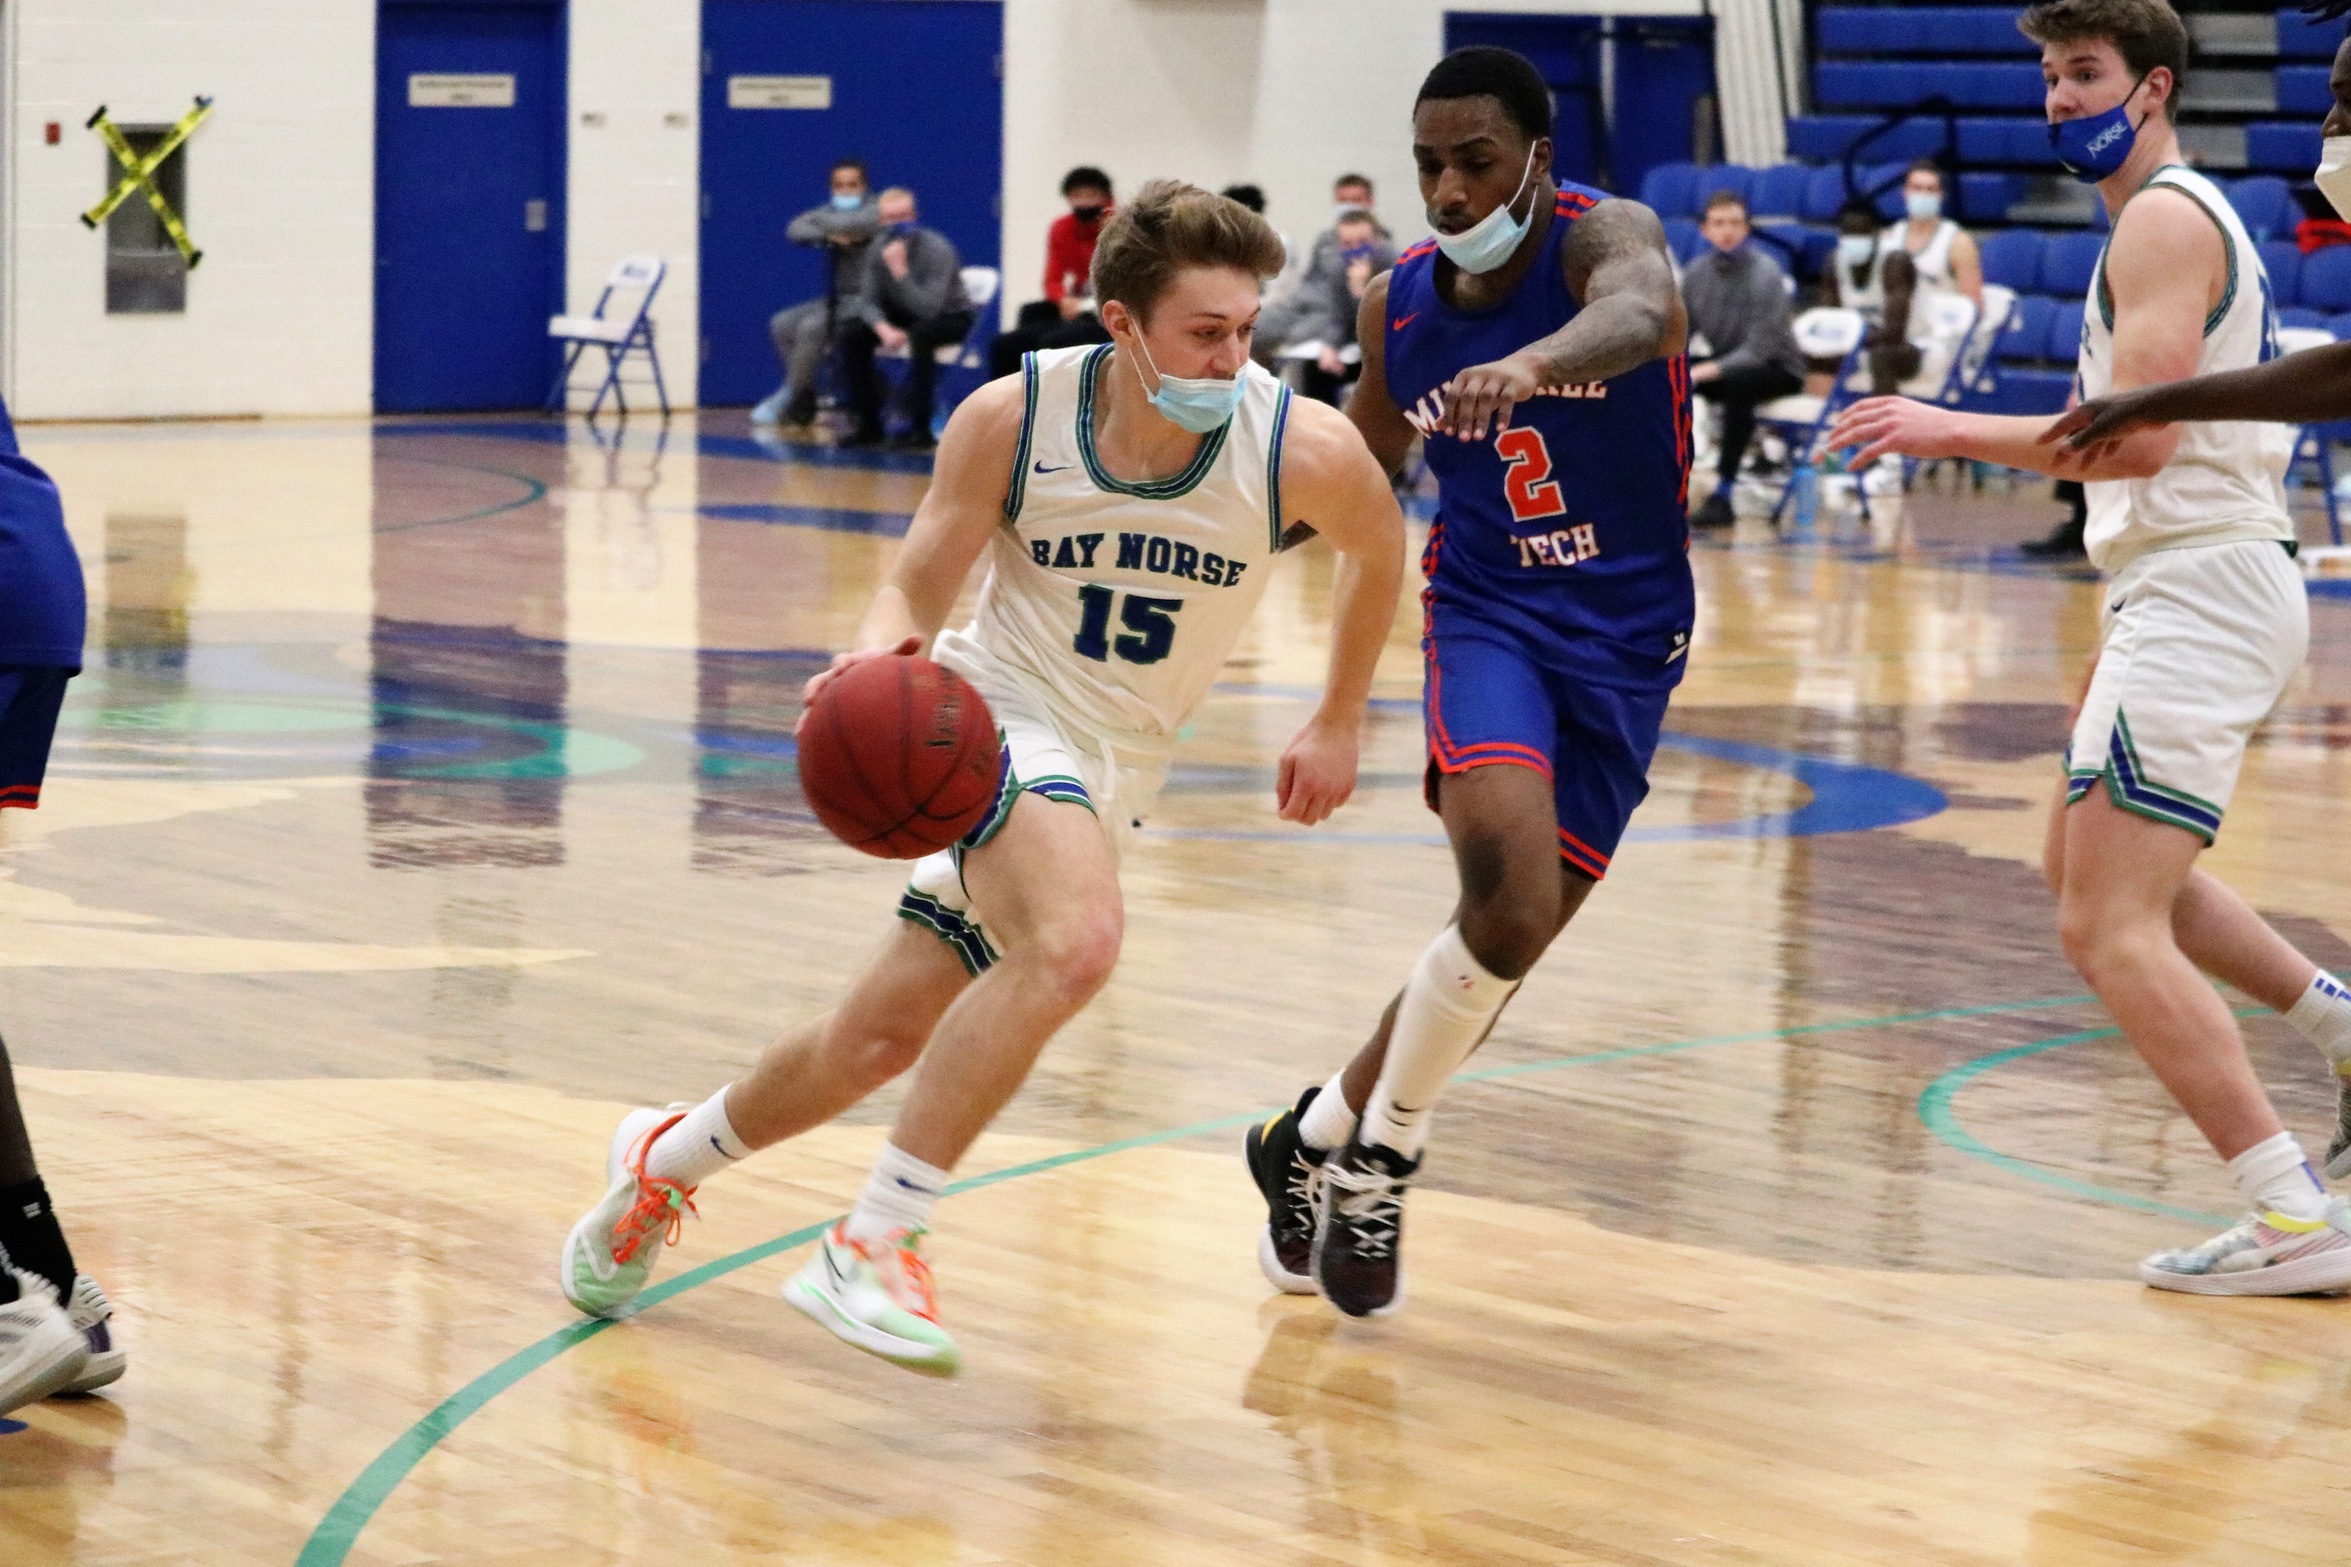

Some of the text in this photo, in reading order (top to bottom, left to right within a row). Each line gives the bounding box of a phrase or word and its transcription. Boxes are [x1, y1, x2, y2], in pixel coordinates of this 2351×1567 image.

[2086, 121, 2127, 160] NORSE
[1494, 425, 1567, 522] 2
[1031, 532, 1248, 588] BAY NORSE
[1510, 522, 1601, 567] TECH
[1073, 583, 1184, 665] 15
